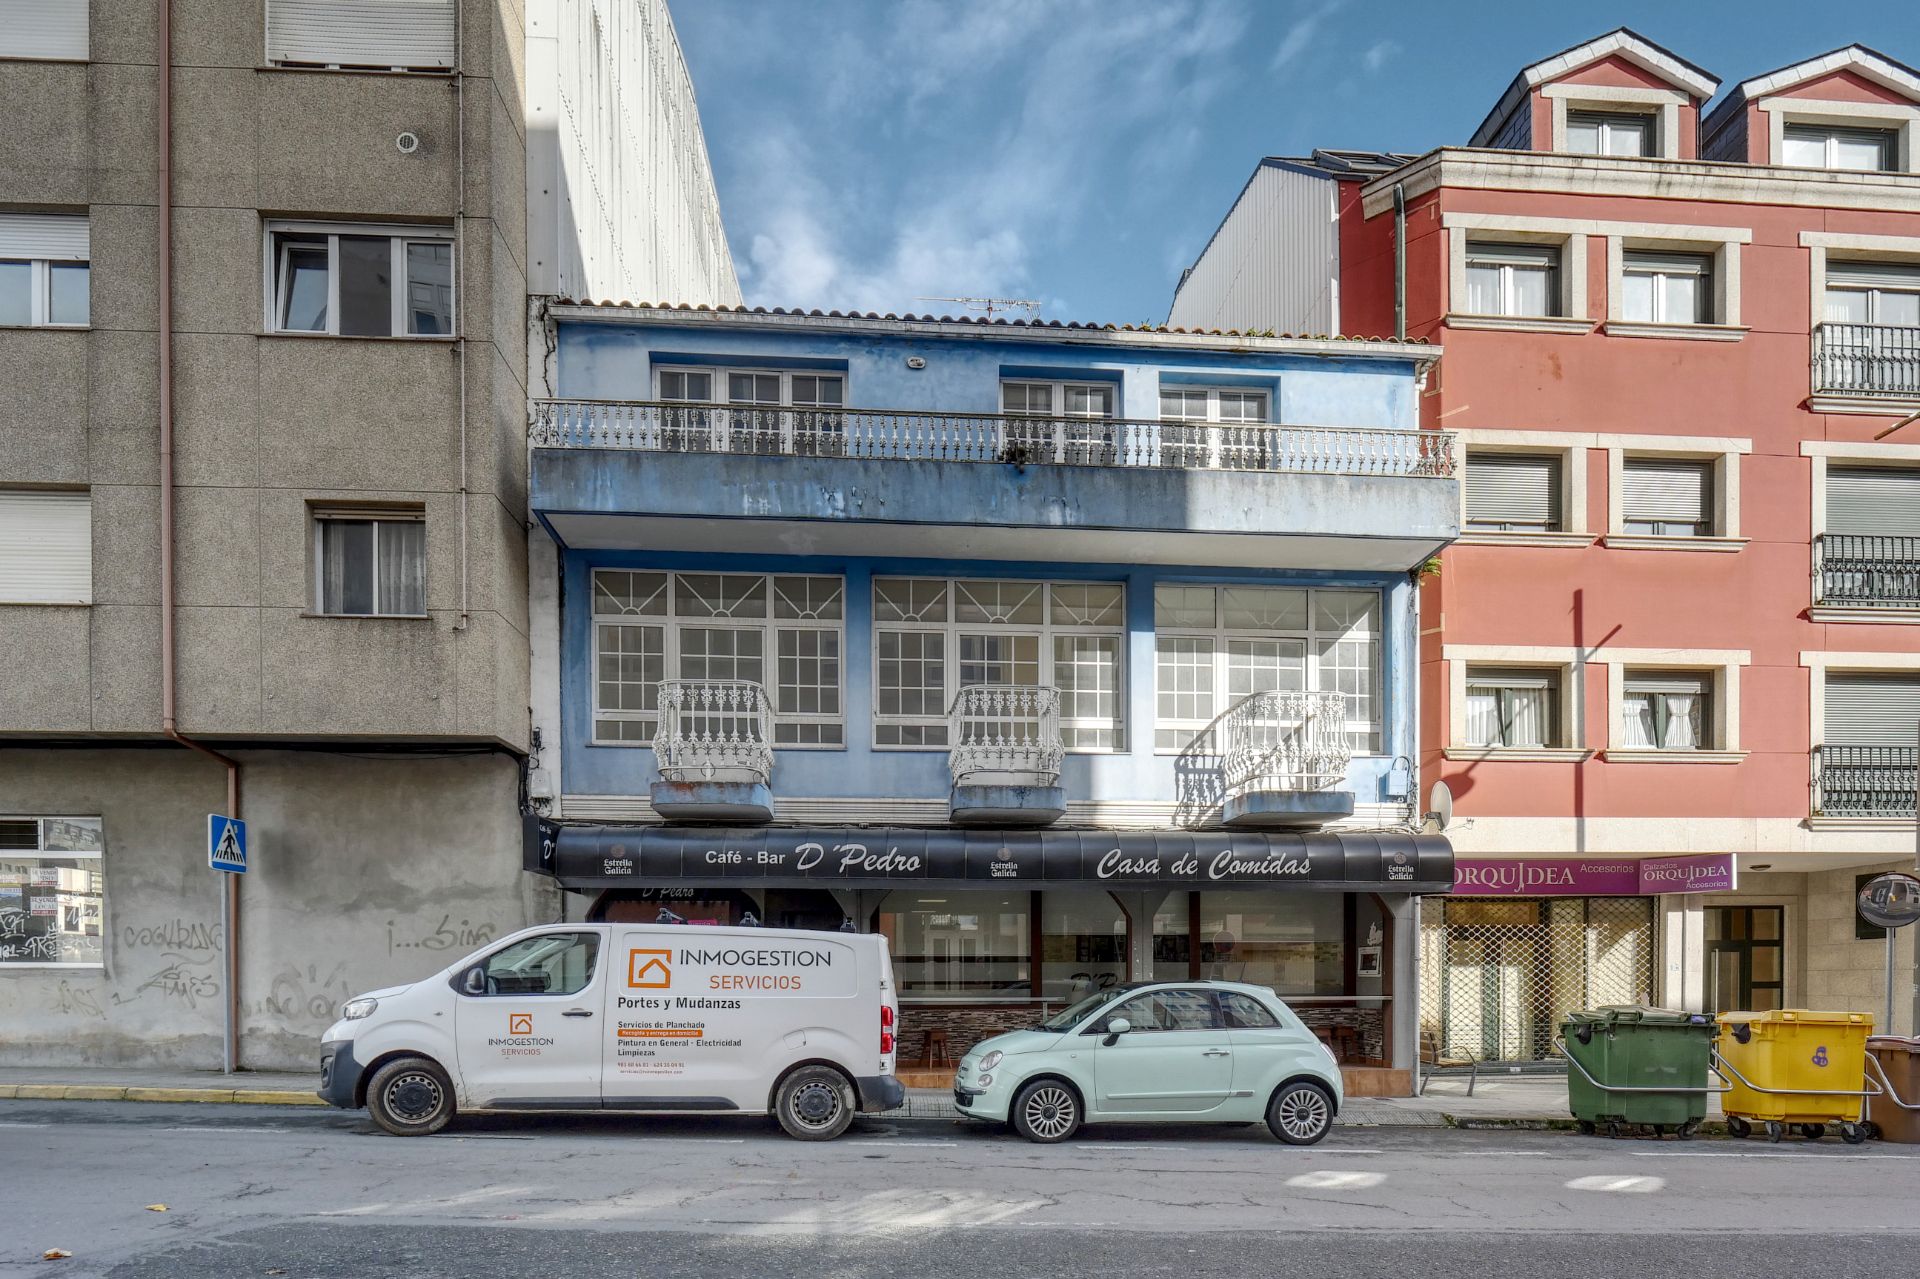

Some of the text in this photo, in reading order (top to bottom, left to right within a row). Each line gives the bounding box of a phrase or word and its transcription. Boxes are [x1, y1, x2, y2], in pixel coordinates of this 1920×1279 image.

[705, 850, 742, 864] Café
[757, 851, 786, 864] Bar
[603, 859, 633, 867] Estrella
[990, 861, 1018, 869] Estrella
[1096, 848, 1312, 880] Casa de Comidas
[1643, 863, 1678, 871] Calzados
[604, 867, 632, 875] Galicia
[1388, 864, 1415, 873] Estrella
[1580, 863, 1634, 873] Accesorios
[991, 869, 1017, 877] Galicia
[1388, 872, 1414, 880] Galicia
[1686, 880, 1728, 889] Accesorios
[680, 949, 831, 967] INMOGESTION
[709, 975, 801, 990] SERVICIOS
[617, 997, 741, 1010] Portes y Mudanzas
[618, 1021, 705, 1029] Servicios de Planchado
[488, 1038, 554, 1046] INMOGESTION
[617, 1039, 646, 1047] Pintura
[660, 1039, 689, 1047] General
[696, 1039, 742, 1047] Electricidad
[501, 1048, 541, 1056] SERVICIOS
[617, 1049, 655, 1057] Limpiezas
